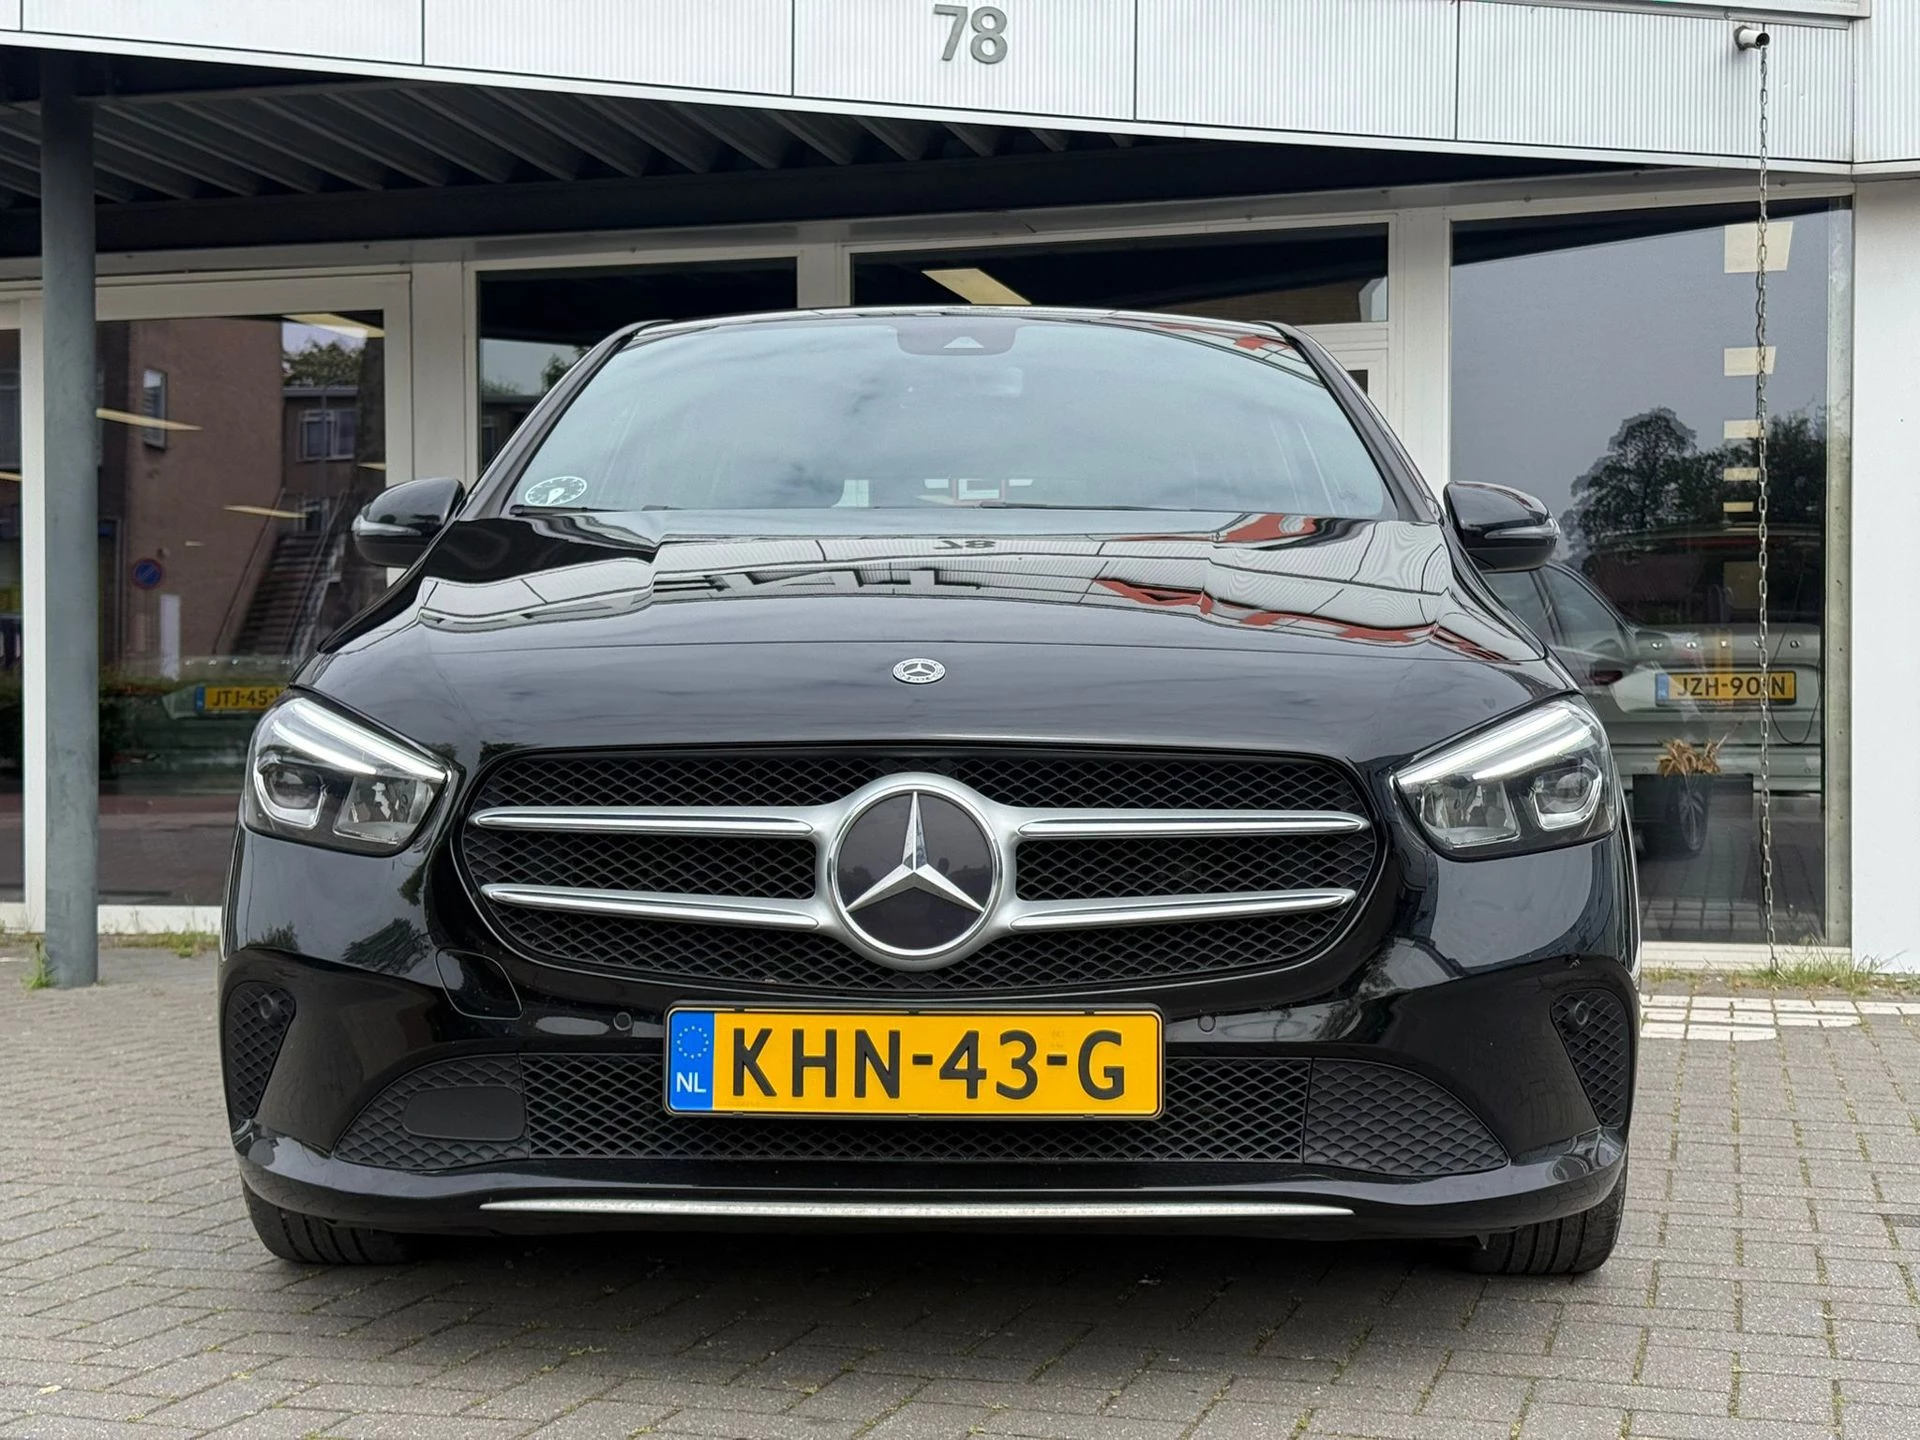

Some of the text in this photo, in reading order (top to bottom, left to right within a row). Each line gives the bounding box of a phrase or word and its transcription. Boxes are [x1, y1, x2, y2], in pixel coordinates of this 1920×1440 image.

[934, 4, 1008, 64] 78
[676, 1027, 1125, 1100] NL KHN-43-G
